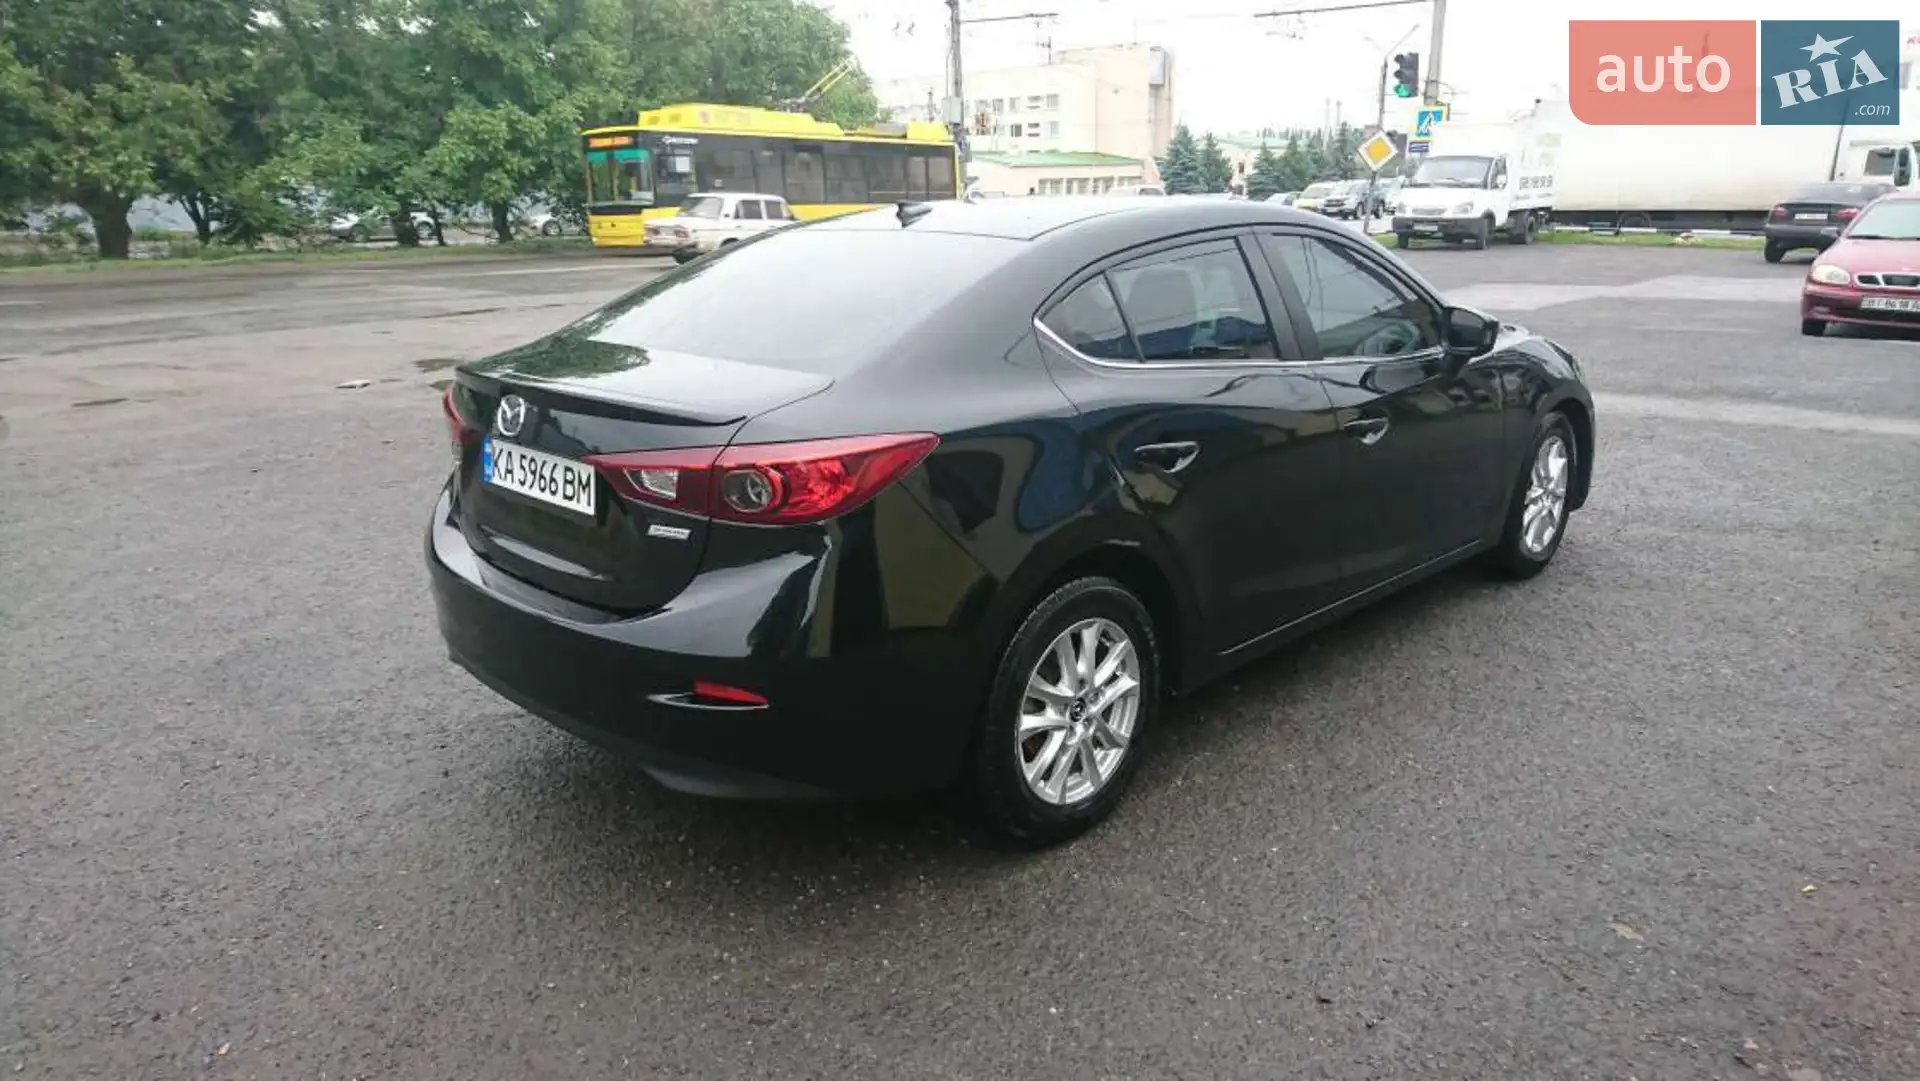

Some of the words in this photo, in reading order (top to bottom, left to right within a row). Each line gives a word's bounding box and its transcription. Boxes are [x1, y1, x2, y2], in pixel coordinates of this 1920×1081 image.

[493, 448, 515, 484] KA
[518, 454, 559, 496] 5966
[563, 465, 592, 507] BM
